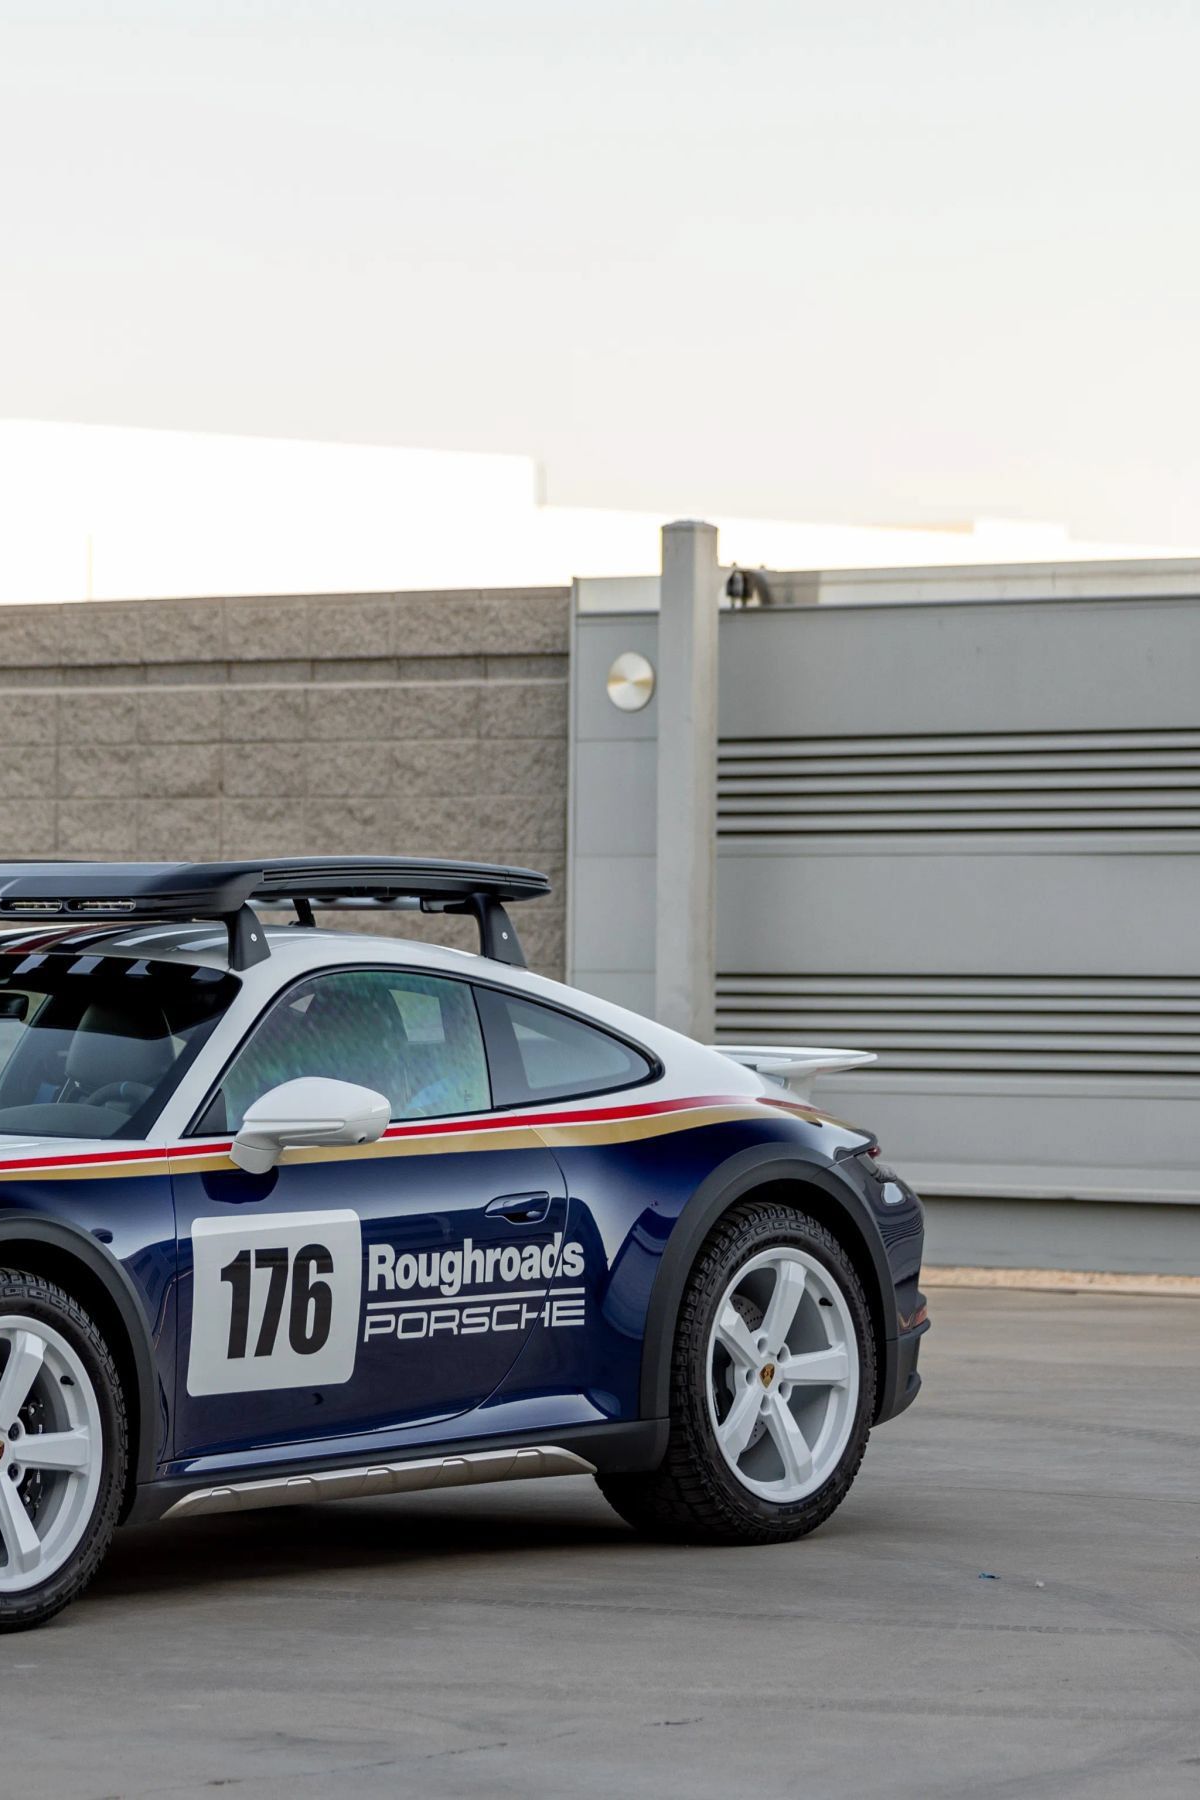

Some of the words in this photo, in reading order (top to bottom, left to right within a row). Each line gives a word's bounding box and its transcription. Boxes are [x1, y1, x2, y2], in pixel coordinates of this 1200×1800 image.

[367, 1231, 586, 1296] Roughroads
[220, 1243, 334, 1360] 176
[363, 1299, 586, 1343] PORSCHE
